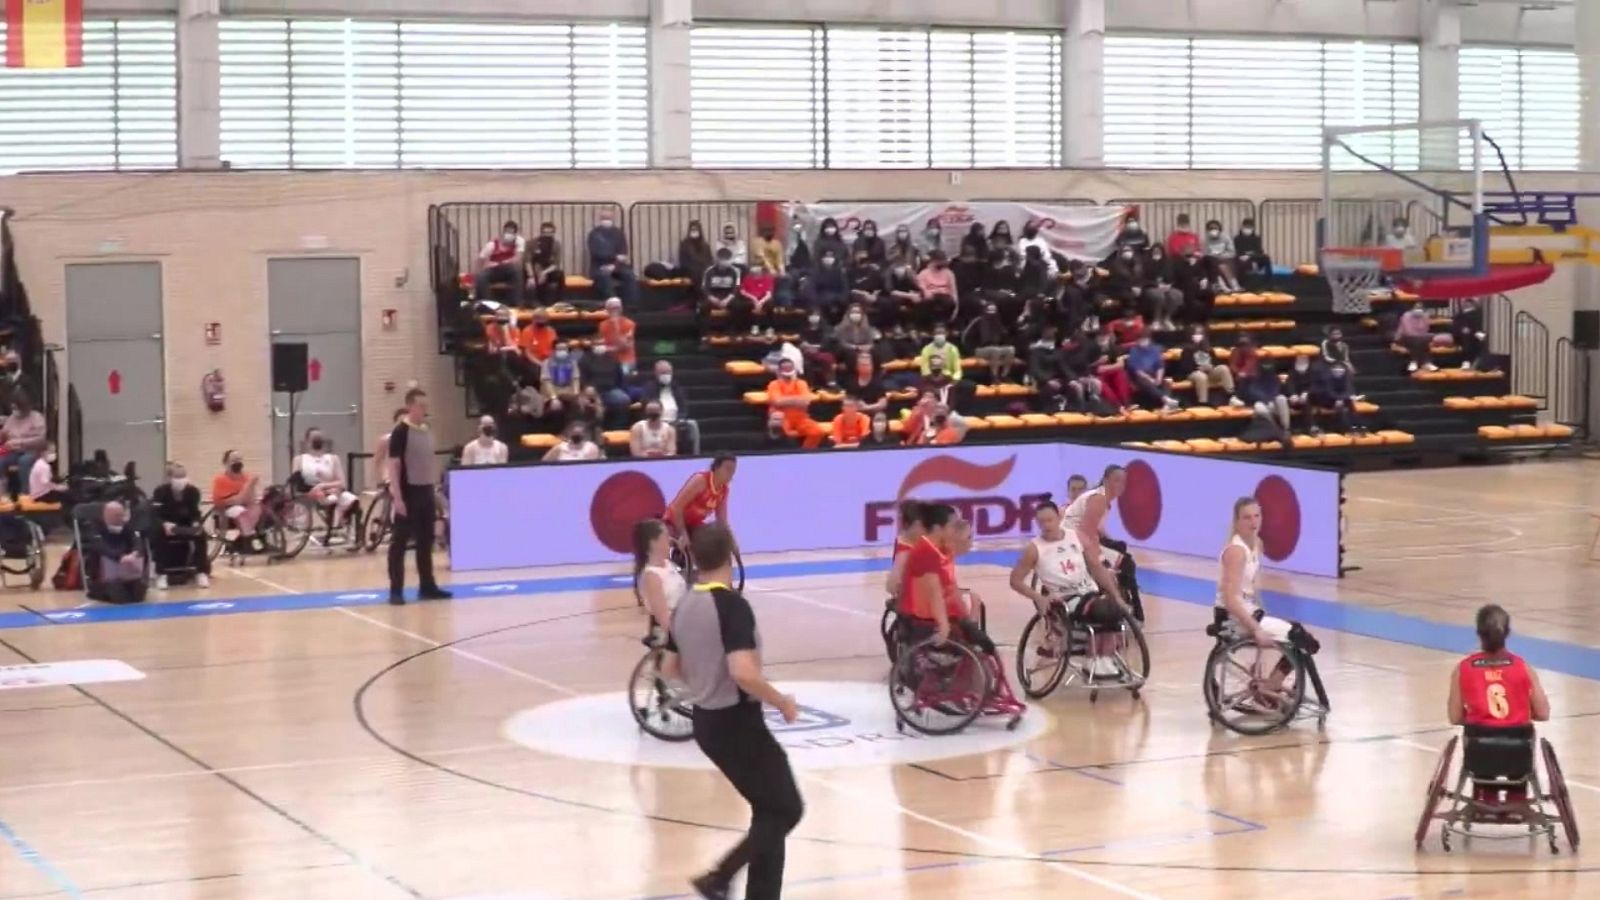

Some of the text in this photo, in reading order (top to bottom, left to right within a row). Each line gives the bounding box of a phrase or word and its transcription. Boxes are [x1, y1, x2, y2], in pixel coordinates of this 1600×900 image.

[865, 493, 1048, 542] FDF
[1060, 559, 1075, 575] 14
[1486, 683, 1510, 719] 6
